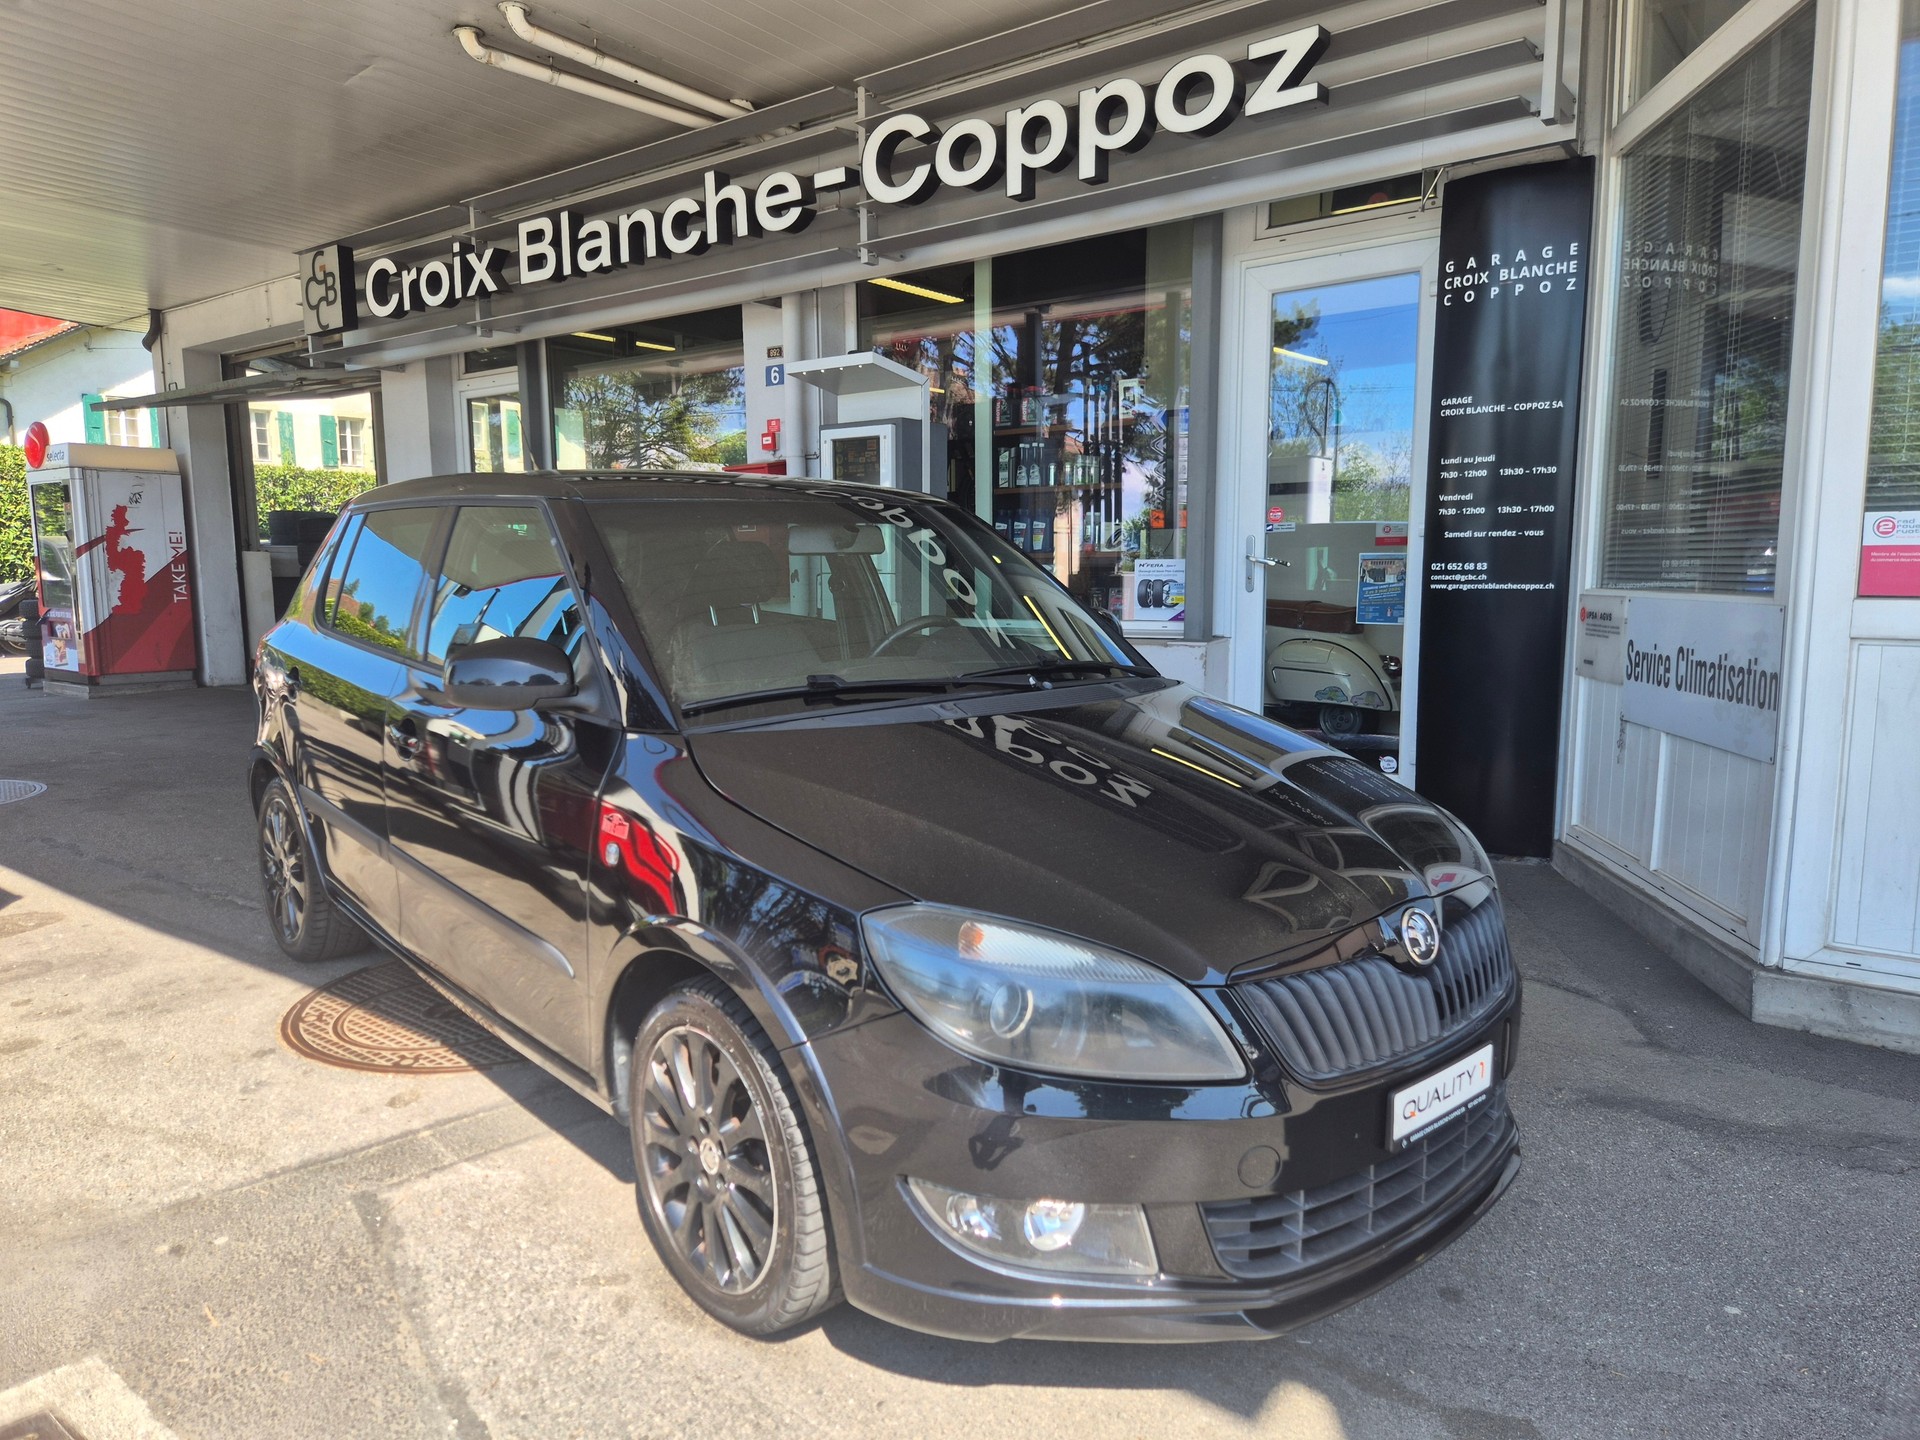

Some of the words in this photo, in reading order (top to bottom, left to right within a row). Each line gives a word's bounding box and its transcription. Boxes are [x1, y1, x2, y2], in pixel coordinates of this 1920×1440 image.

[365, 242, 500, 318] Croix
[1444, 271, 1489, 290] CROIX
[1499, 260, 1578, 281] BLANCHE
[770, 367, 780, 384] 6
[1441, 396, 1473, 406] GARAGE
[1440, 407, 1465, 417] CROIX
[1466, 404, 1506, 415] BLANCHE
[1514, 401, 1551, 411] COPPOZ
[1552, 400, 1564, 408] SA
[46, 450, 65, 462] selecta
[1474, 454, 1496, 464] Jeudi
[1464, 470, 1488, 478] 12h00
[1500, 468, 1524, 476] 13h30
[1532, 466, 1557, 474] 17h30
[1438, 493, 1474, 502] Vendredi
[1438, 508, 1456, 516] 7h30
[1462, 507, 1486, 515] 12h00
[1530, 505, 1554, 513] 17h00
[1444, 530, 1472, 538] Samedi
[1488, 530, 1516, 538] rendez
[168, 532, 184, 560] ME!
[1430, 562, 1446, 570] 021
[1446, 562, 1462, 570] 652
[171, 564, 188, 604] TAKE
[1430, 582, 1555, 590] www.garagecroixblanchecoppoz.ch
[1626, 639, 1670, 689] Service
[1675, 646, 1779, 712] Climatisation
